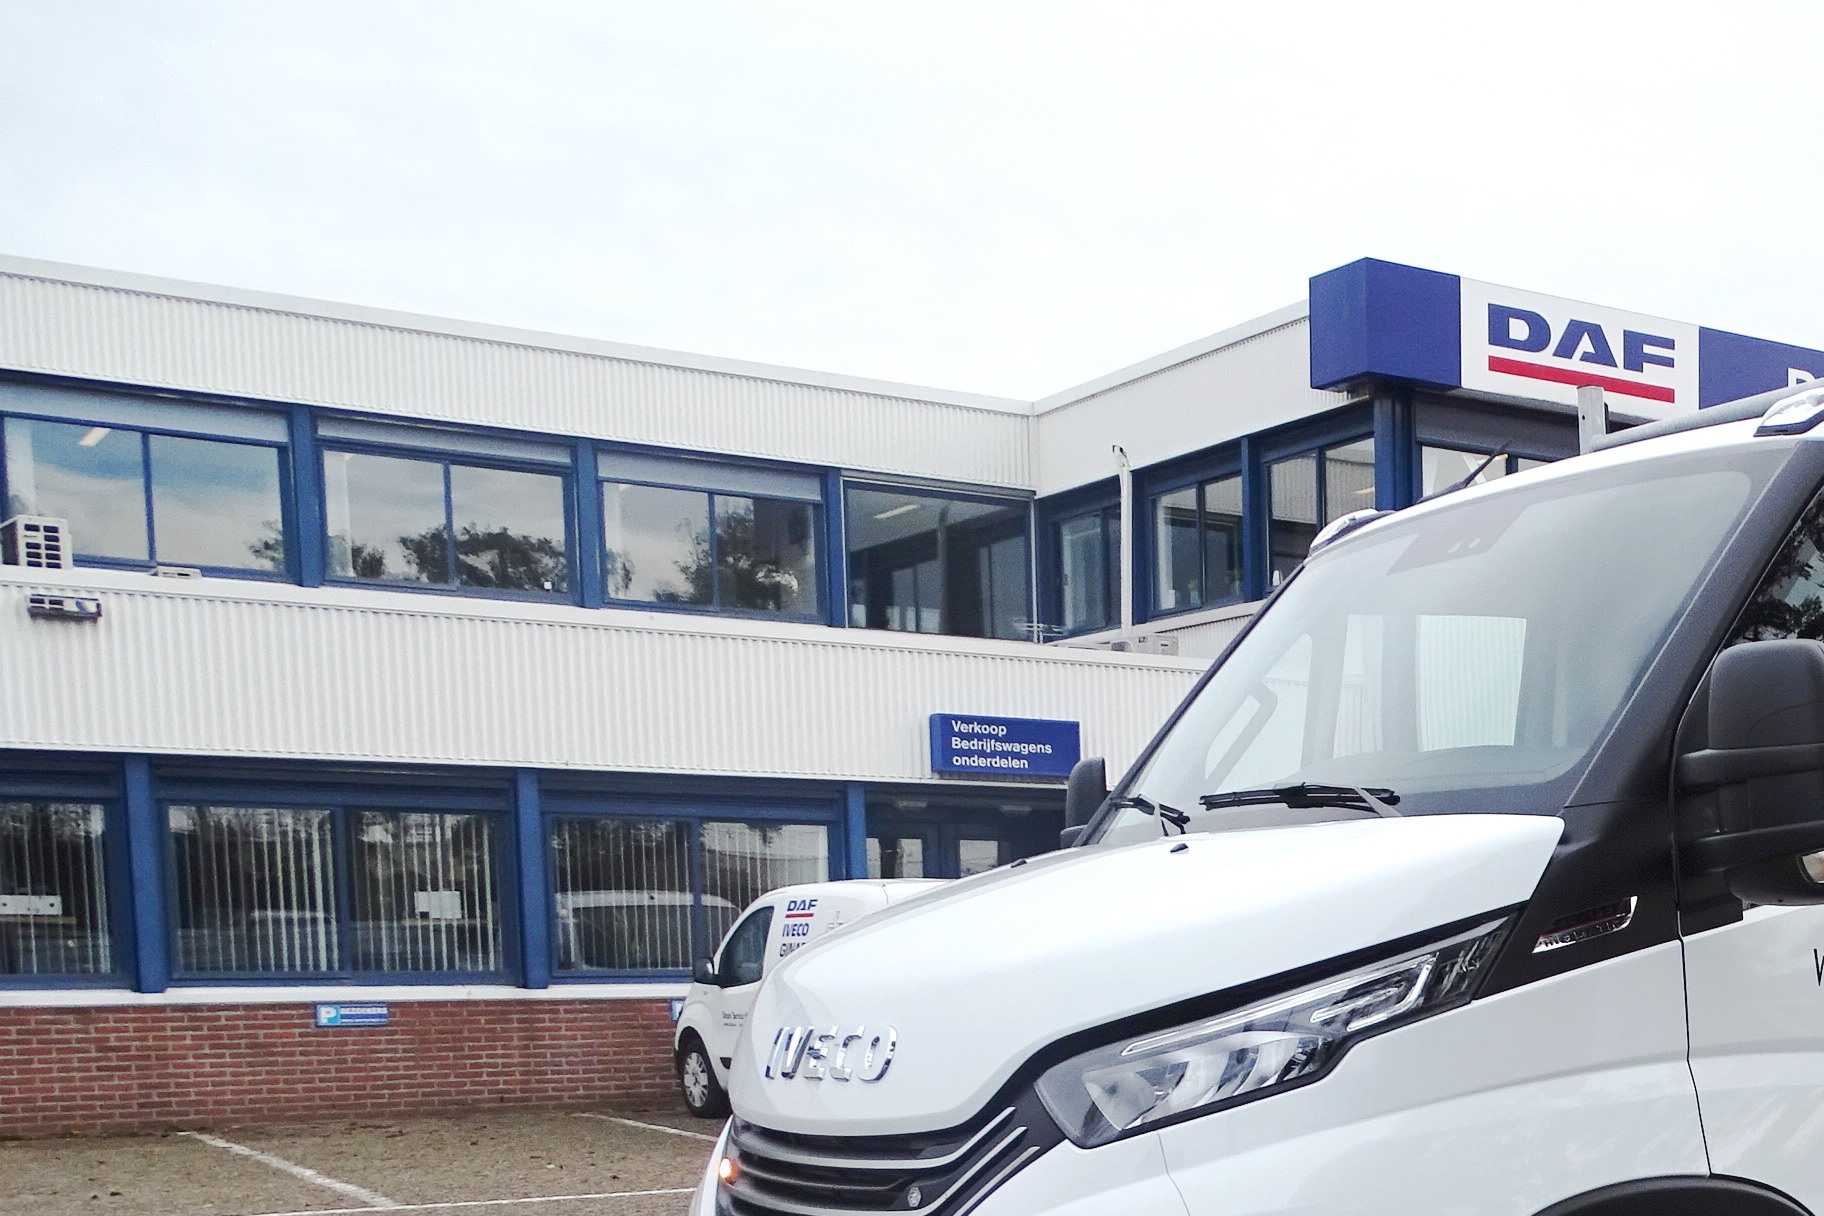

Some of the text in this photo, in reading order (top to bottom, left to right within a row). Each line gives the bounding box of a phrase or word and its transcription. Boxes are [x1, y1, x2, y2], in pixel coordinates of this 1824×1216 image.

[1488, 302, 1676, 373] DAF
[951, 720, 1007, 736] Verkoop
[951, 737, 1052, 754] Bedrijfswagens
[952, 755, 1029, 769] onderdelen
[786, 899, 818, 912] DAF
[782, 922, 810, 937] IVECO
[320, 1007, 337, 1024] P
[764, 1025, 898, 1083] IVECO
